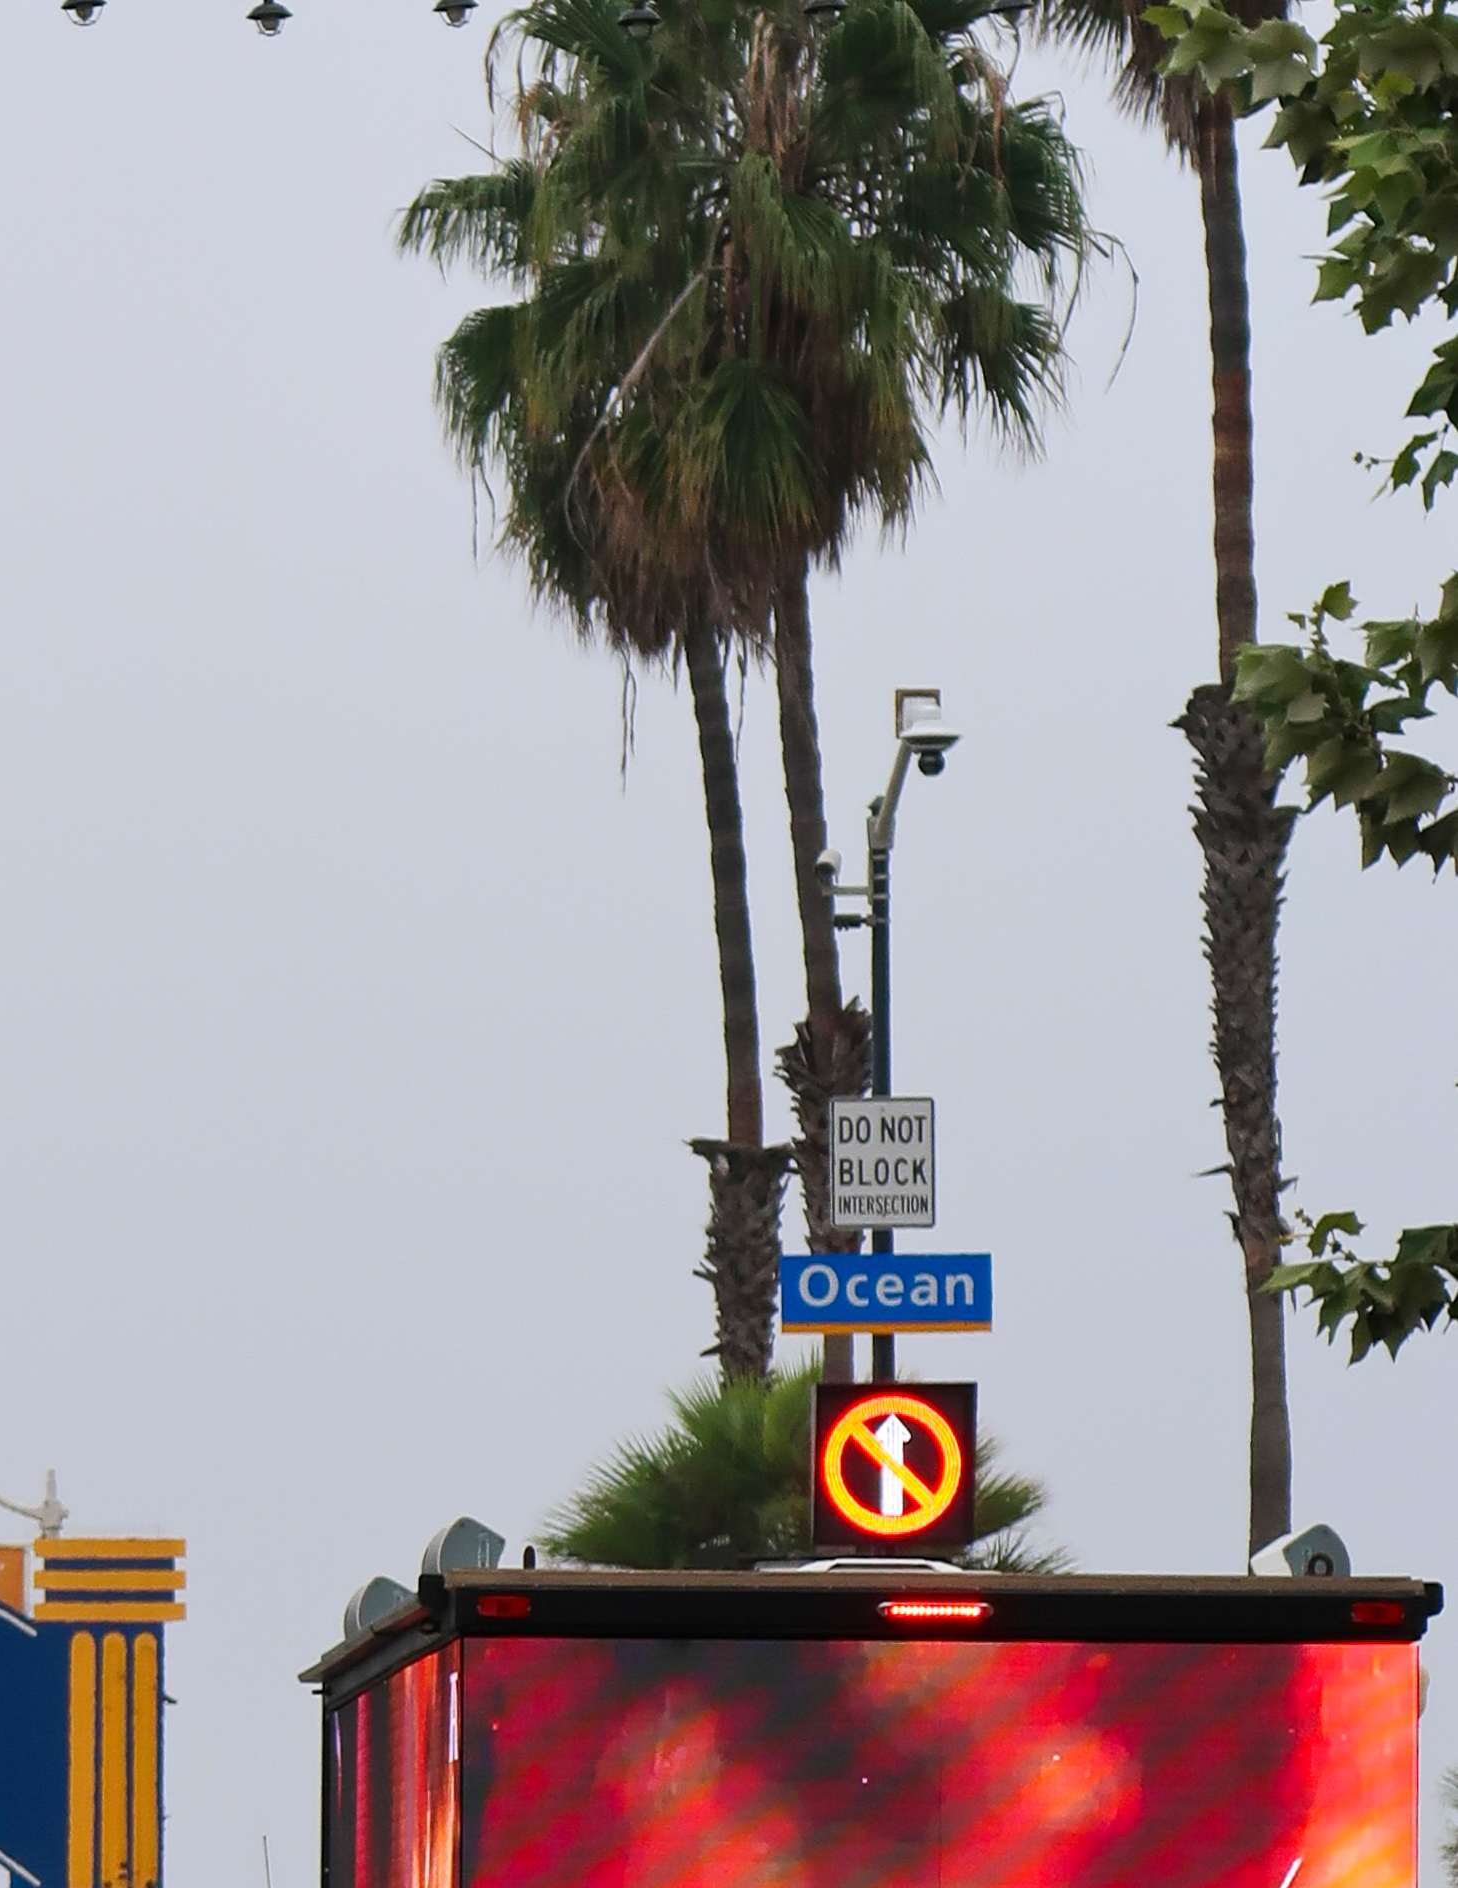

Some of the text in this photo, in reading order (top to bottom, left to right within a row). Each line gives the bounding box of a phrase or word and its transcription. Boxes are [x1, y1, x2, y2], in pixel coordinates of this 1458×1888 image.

[839, 1115, 927, 1144] DO NOT
[839, 1157, 928, 1186] BLOCK
[838, 1195, 929, 1216] INTERSECTION
[797, 1263, 975, 1308] Ocean
